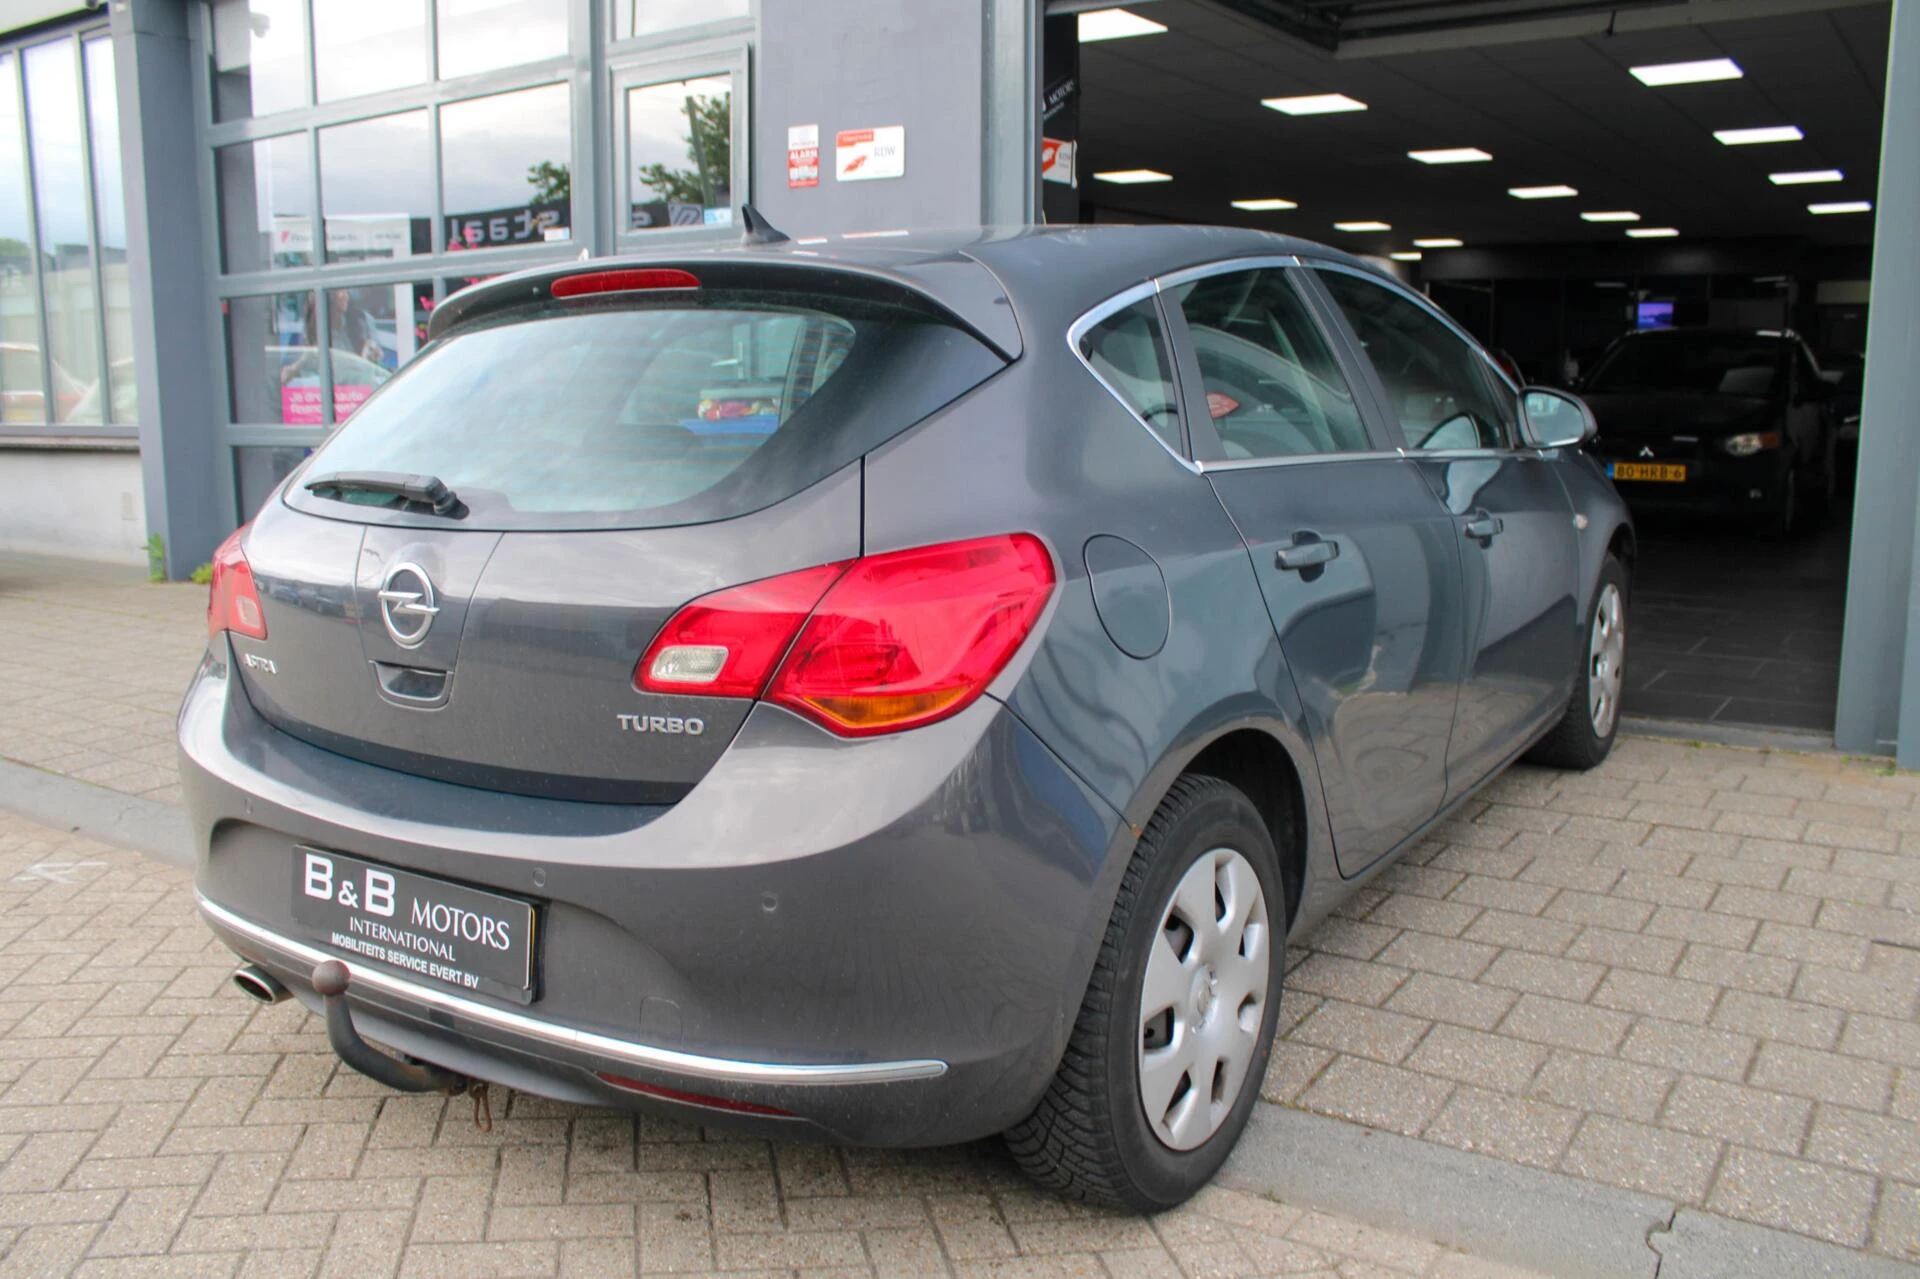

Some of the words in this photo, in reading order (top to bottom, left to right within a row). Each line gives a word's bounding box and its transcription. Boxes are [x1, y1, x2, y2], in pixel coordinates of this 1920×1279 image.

[616, 714, 704, 735] TURBO
[305, 853, 333, 900] B
[338, 880, 359, 908] &
[365, 868, 395, 917] B
[411, 897, 510, 950] MOTORS
[331, 931, 386, 960] MOBILITEITS
[387, 950, 427, 974] SERVICE
[429, 962, 462, 984] EVERT
[464, 972, 479, 989] BV
[349, 916, 456, 962] INTERNATIONAL
